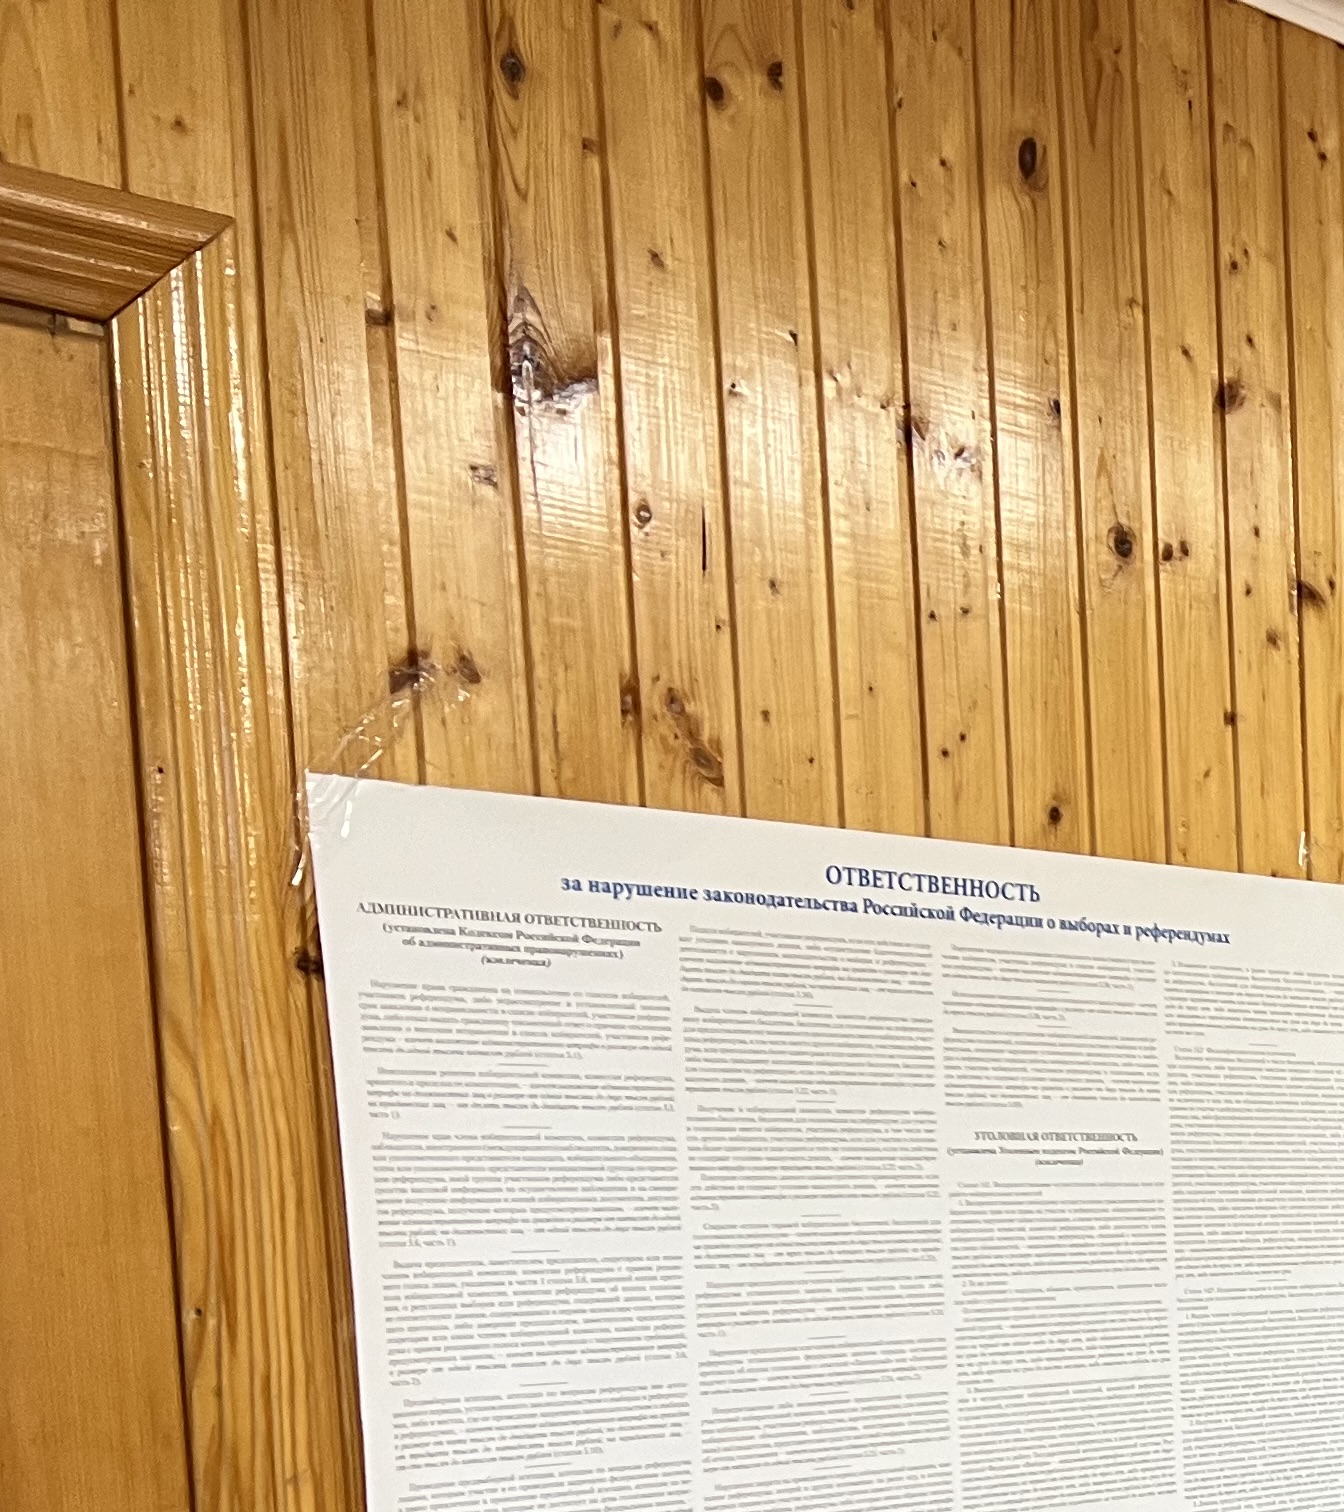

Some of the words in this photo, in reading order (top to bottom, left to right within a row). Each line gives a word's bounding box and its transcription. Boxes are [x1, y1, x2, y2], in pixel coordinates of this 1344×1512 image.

[825, 865, 1041, 902] ОТВЕТСТВЕННОСТЬ
[356, 901, 521, 924] АДМИНИСТРАТИВНАЯ
[524, 913, 663, 933] ОТВЕТСТВЕННОСТЬ
[560, 877, 583, 892] за
[588, 879, 699, 900] нарушение
[702, 887, 859, 913] законодательства
[862, 898, 955, 921] Российской
[959, 907, 1044, 930] Федерации
[1047, 918, 1056, 930] о
[1058, 917, 1120, 938] выборах
[1134, 923, 1231, 946] референдумах
